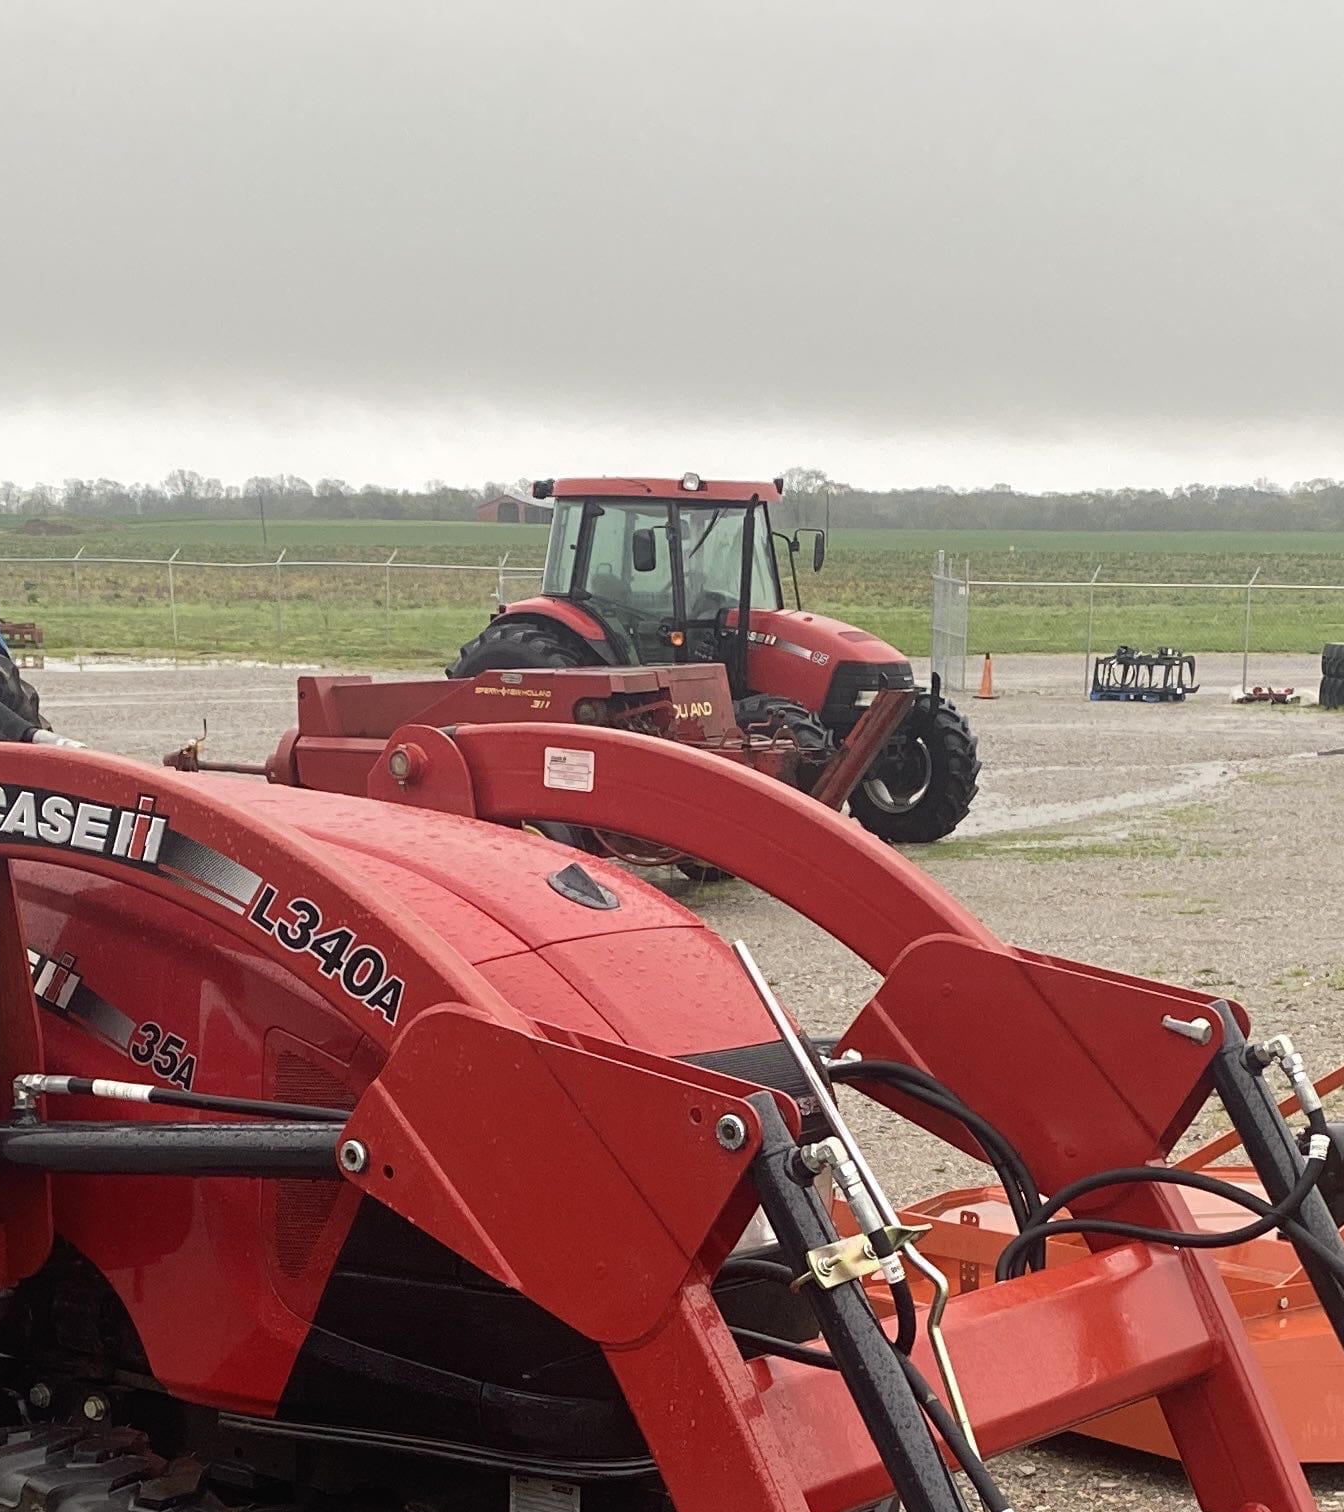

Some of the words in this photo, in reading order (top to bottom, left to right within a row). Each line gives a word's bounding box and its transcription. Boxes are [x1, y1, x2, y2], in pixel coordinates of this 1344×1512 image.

[531, 700, 550, 708] 311
[248, 883, 405, 1026] L340A
[130, 1021, 197, 1092] 35A
